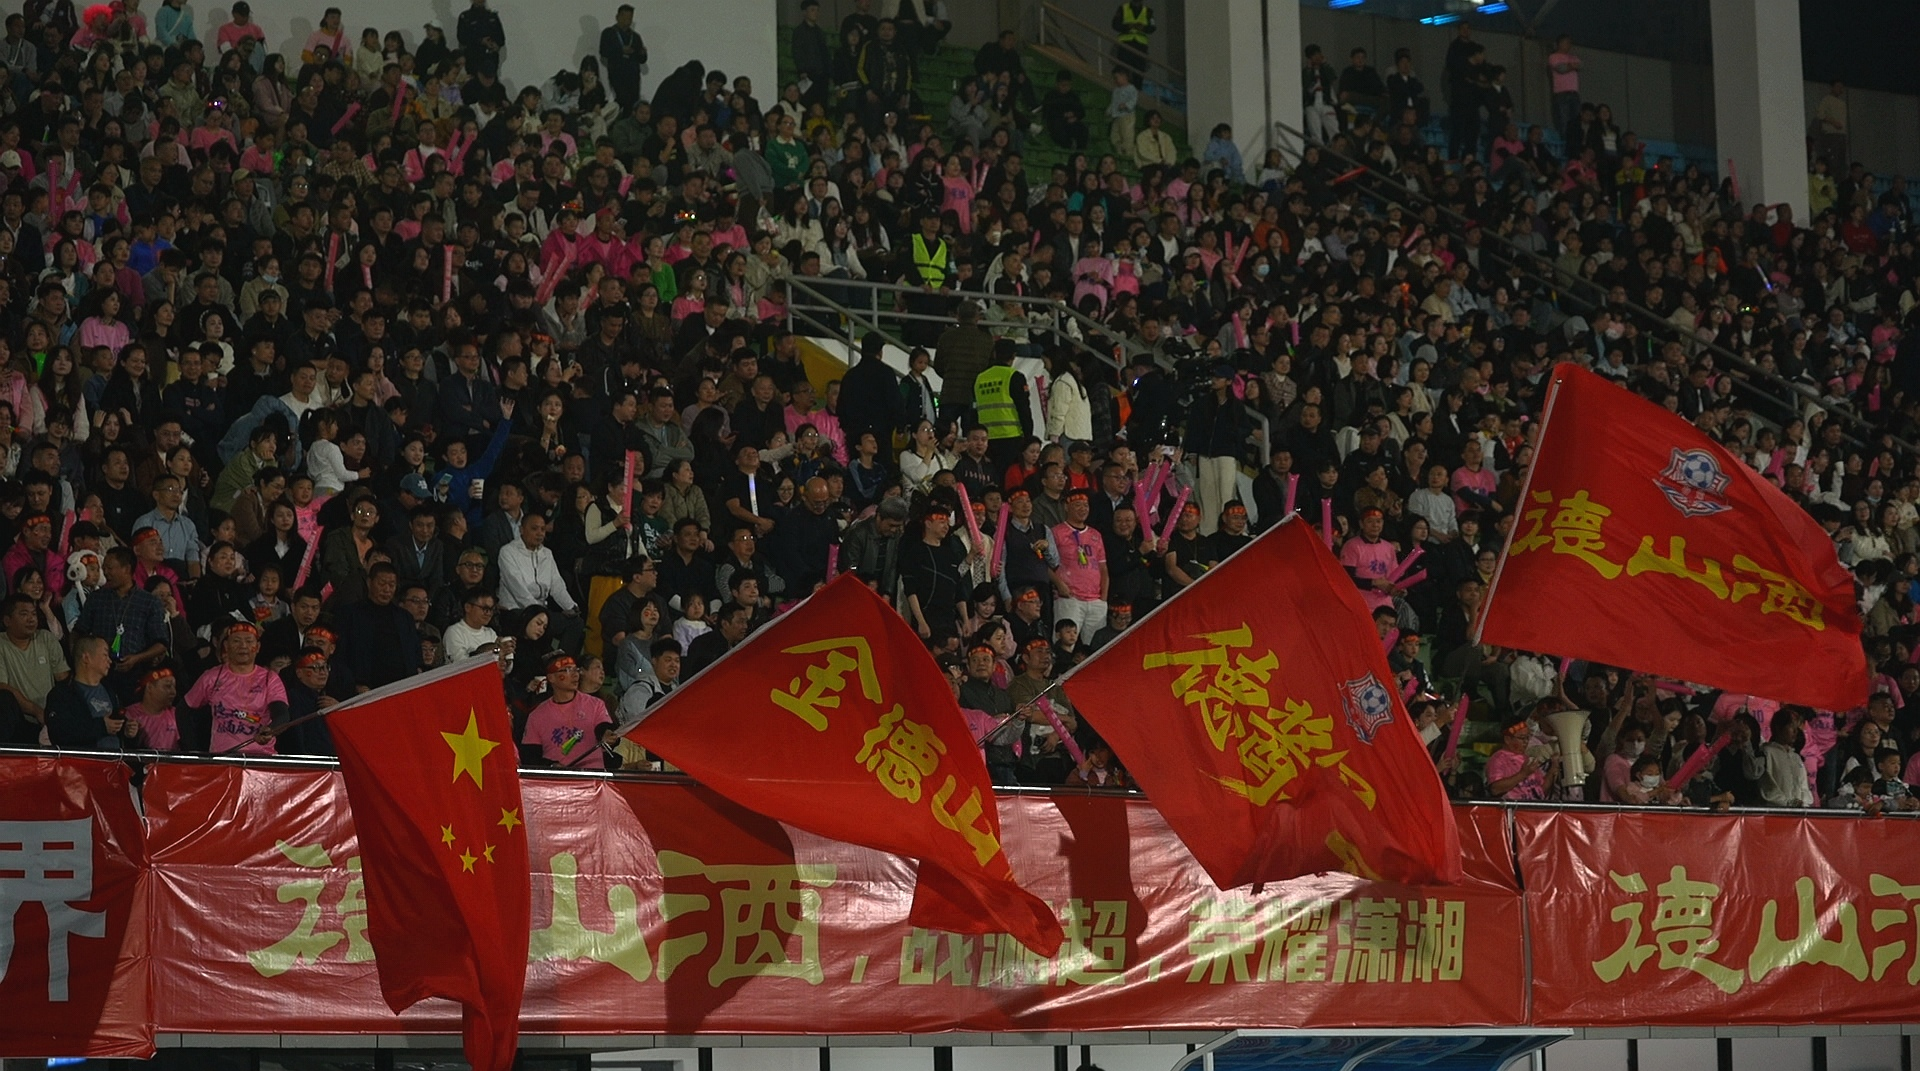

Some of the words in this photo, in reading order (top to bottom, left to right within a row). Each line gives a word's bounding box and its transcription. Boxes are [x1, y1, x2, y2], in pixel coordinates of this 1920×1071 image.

[1510, 490, 1825, 632] 德山酒
[1143, 621, 1377, 812] 德酱
[0, 817, 107, 1002] 界
